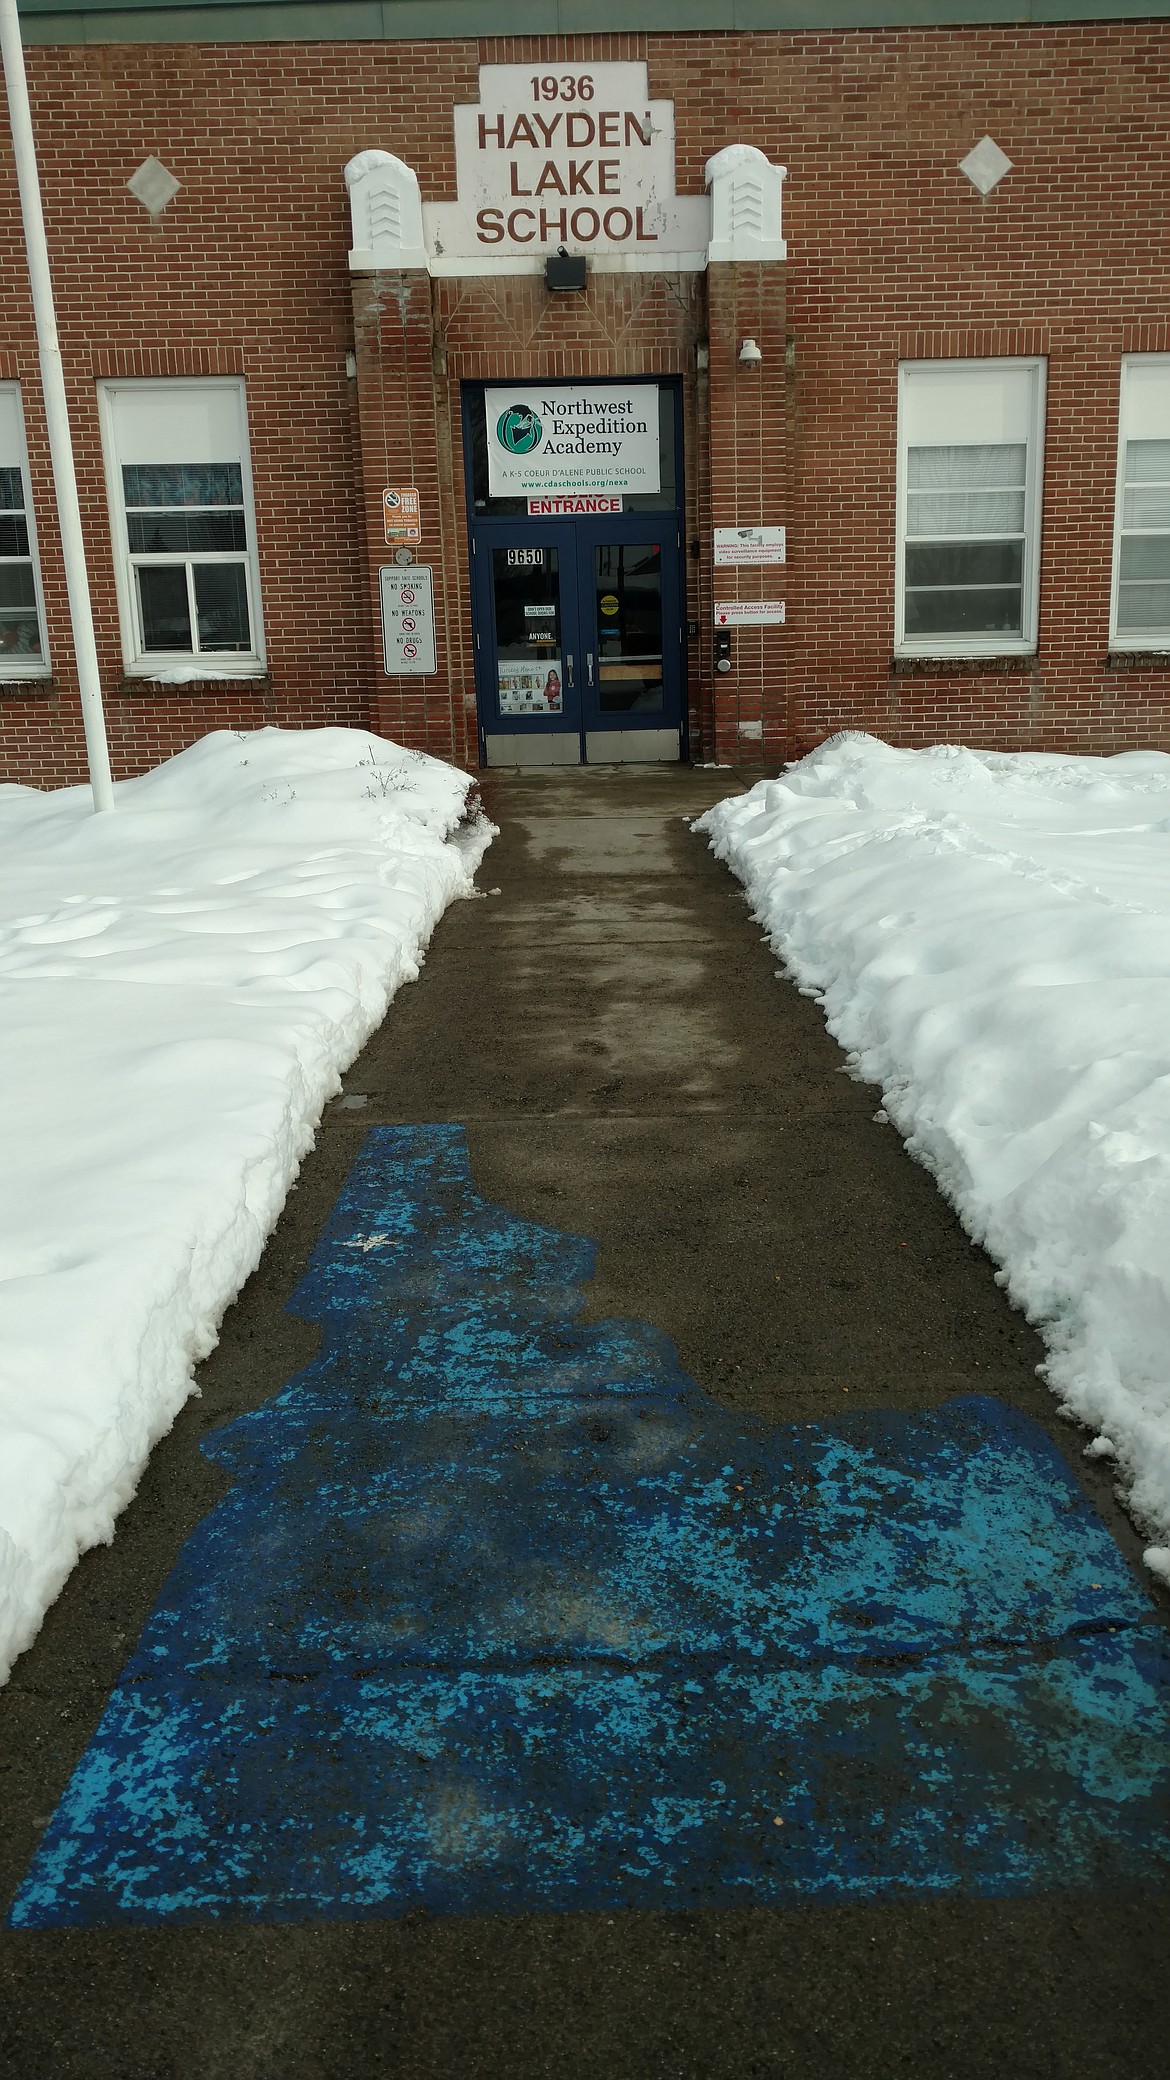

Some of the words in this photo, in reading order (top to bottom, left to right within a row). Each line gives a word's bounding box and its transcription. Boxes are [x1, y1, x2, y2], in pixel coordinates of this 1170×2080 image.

[530, 74, 595, 102] 1936
[477, 110, 652, 149] HAYDEN
[510, 159, 621, 196] LAKE
[476, 206, 658, 244] SCHOOL
[542, 399, 633, 416] Northwest
[552, 418, 648, 438] Expedition
[542, 438, 622, 456] Academy
[521, 479, 628, 488] www.cdaschools.org/nexa
[530, 499, 620, 514] ENTRANCE
[509, 550, 542, 564] 9650
